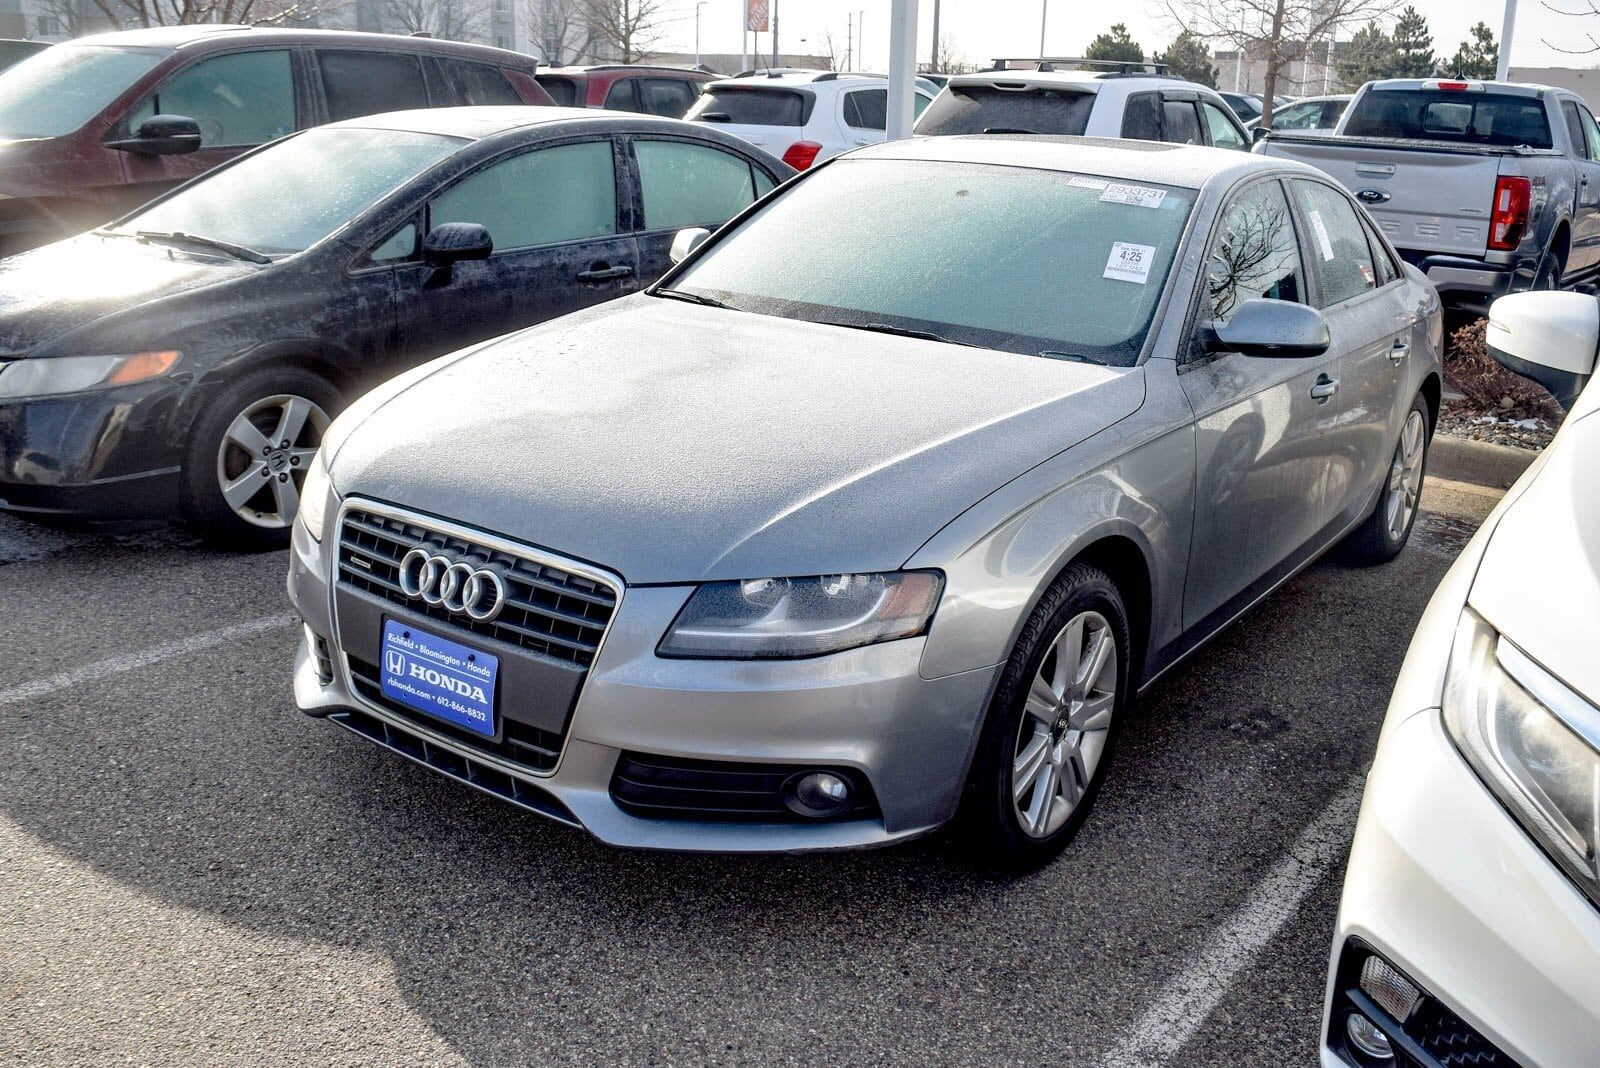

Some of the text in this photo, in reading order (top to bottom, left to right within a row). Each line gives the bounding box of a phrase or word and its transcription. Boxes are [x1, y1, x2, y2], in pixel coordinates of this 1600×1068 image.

[1378, 220, 1480, 241] GER
[1120, 251, 1142, 262] 4:25
[387, 633, 491, 677] Richfield Bloomington Honda
[388, 677, 486, 721] rbhonda.com 612-866-8832
[409, 663, 488, 704] HONDA
